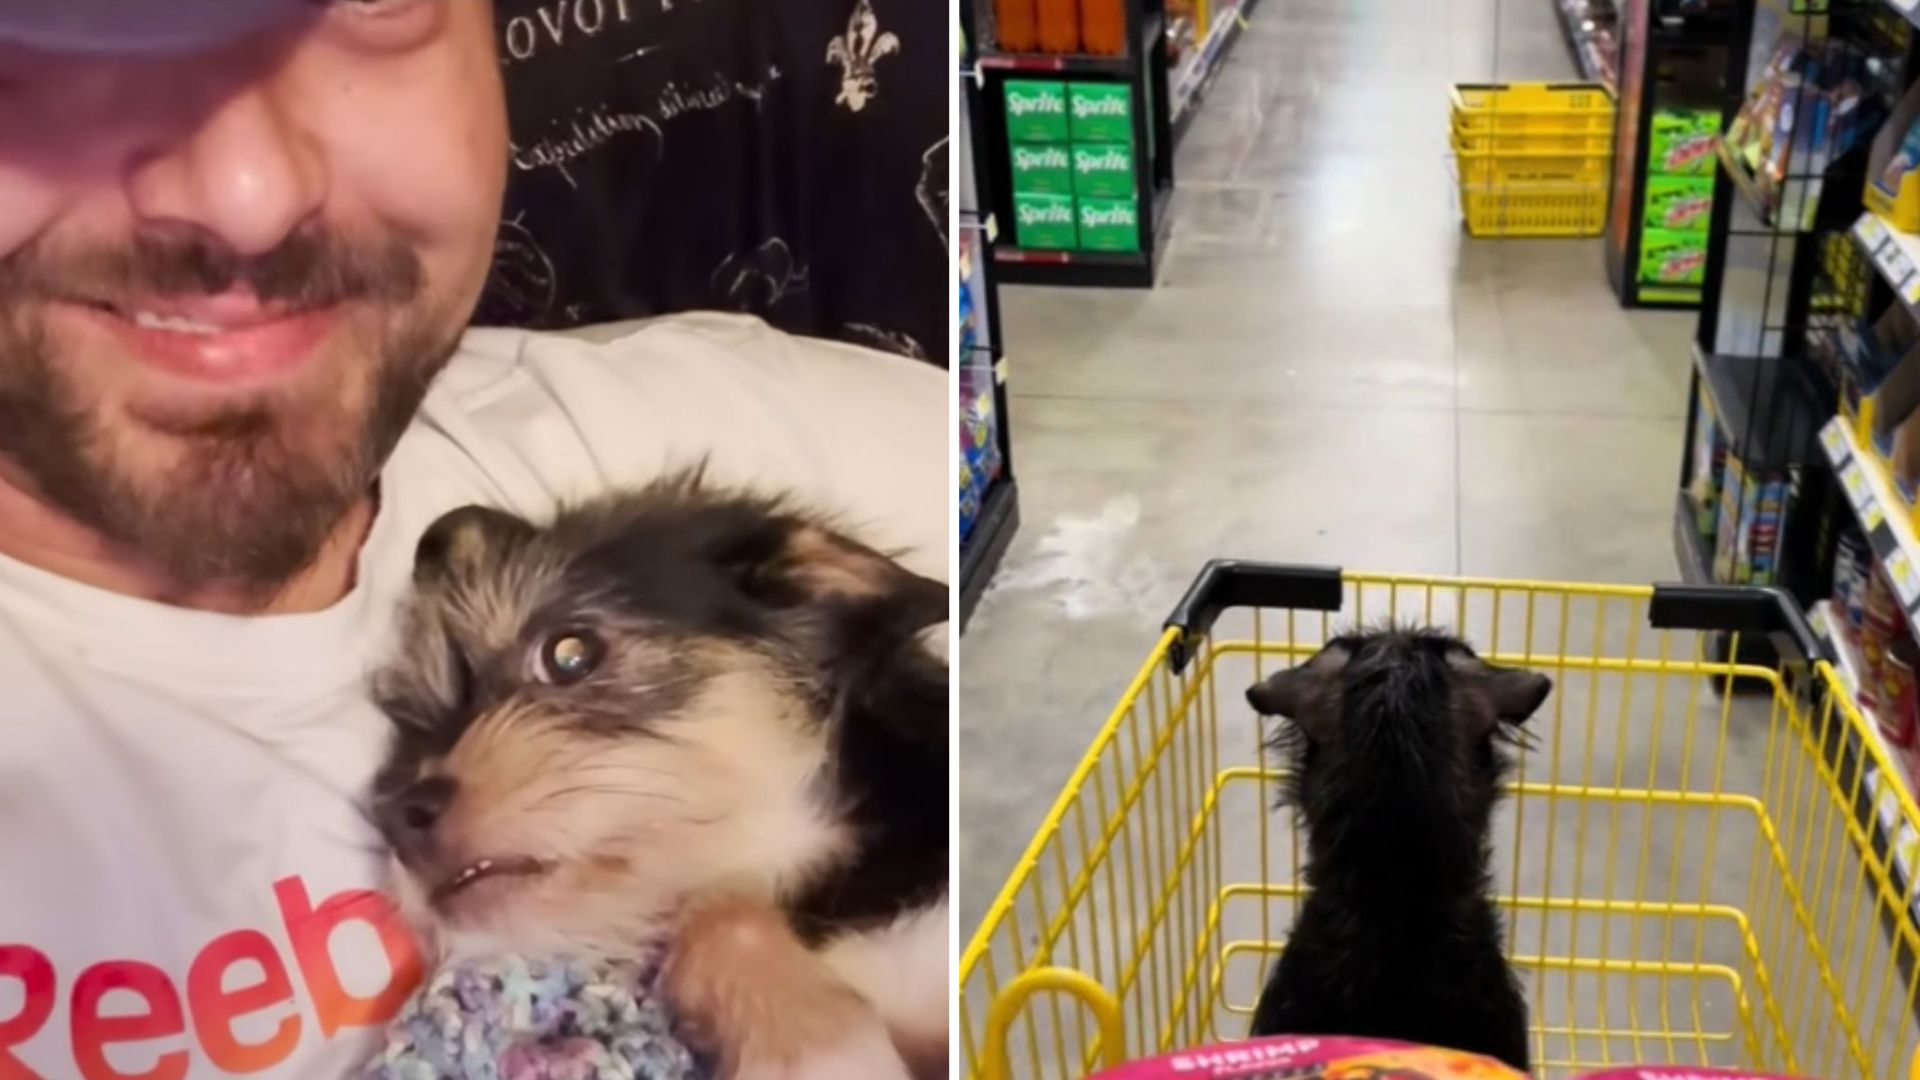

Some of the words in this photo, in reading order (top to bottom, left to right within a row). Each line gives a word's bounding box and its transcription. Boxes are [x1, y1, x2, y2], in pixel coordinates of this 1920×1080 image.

[1007, 91, 1064, 116] Sprite
[1072, 93, 1127, 118] Sprite
[1014, 146, 1068, 171] Sprite
[1075, 149, 1128, 173] Sprite
[1018, 202, 1072, 225] Sprite
[1081, 204, 1134, 228] Sprite
[1170, 1038, 1320, 1072] SHRIMP
